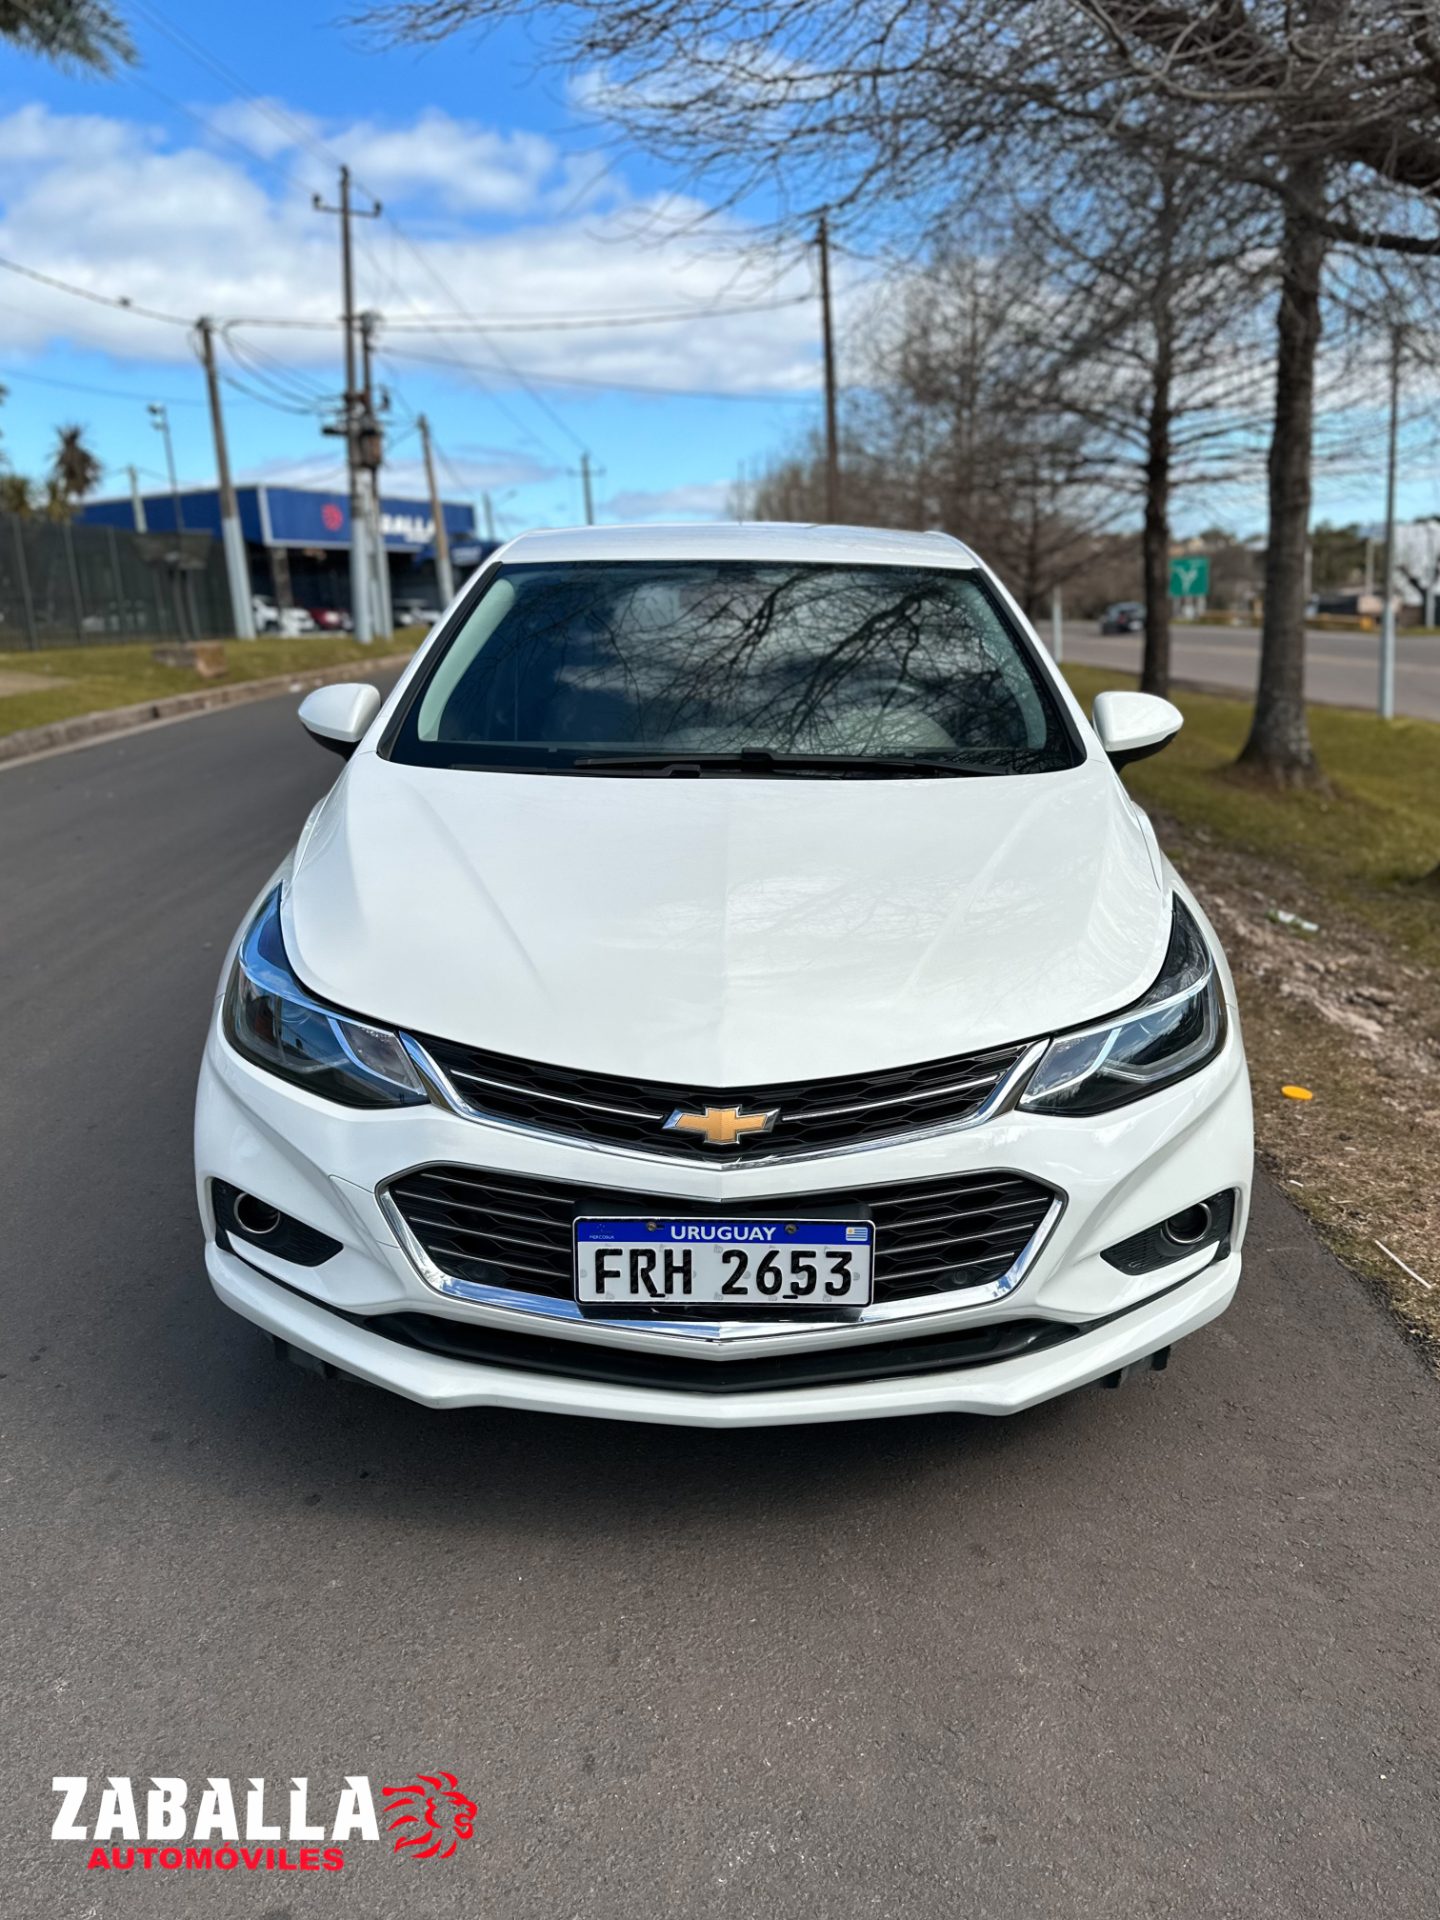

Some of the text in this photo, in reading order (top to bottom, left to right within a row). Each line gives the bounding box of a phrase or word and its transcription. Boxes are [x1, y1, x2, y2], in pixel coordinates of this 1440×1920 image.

[670, 1226, 776, 1241] URUGUAY
[595, 1248, 852, 1297] FRH 2653
